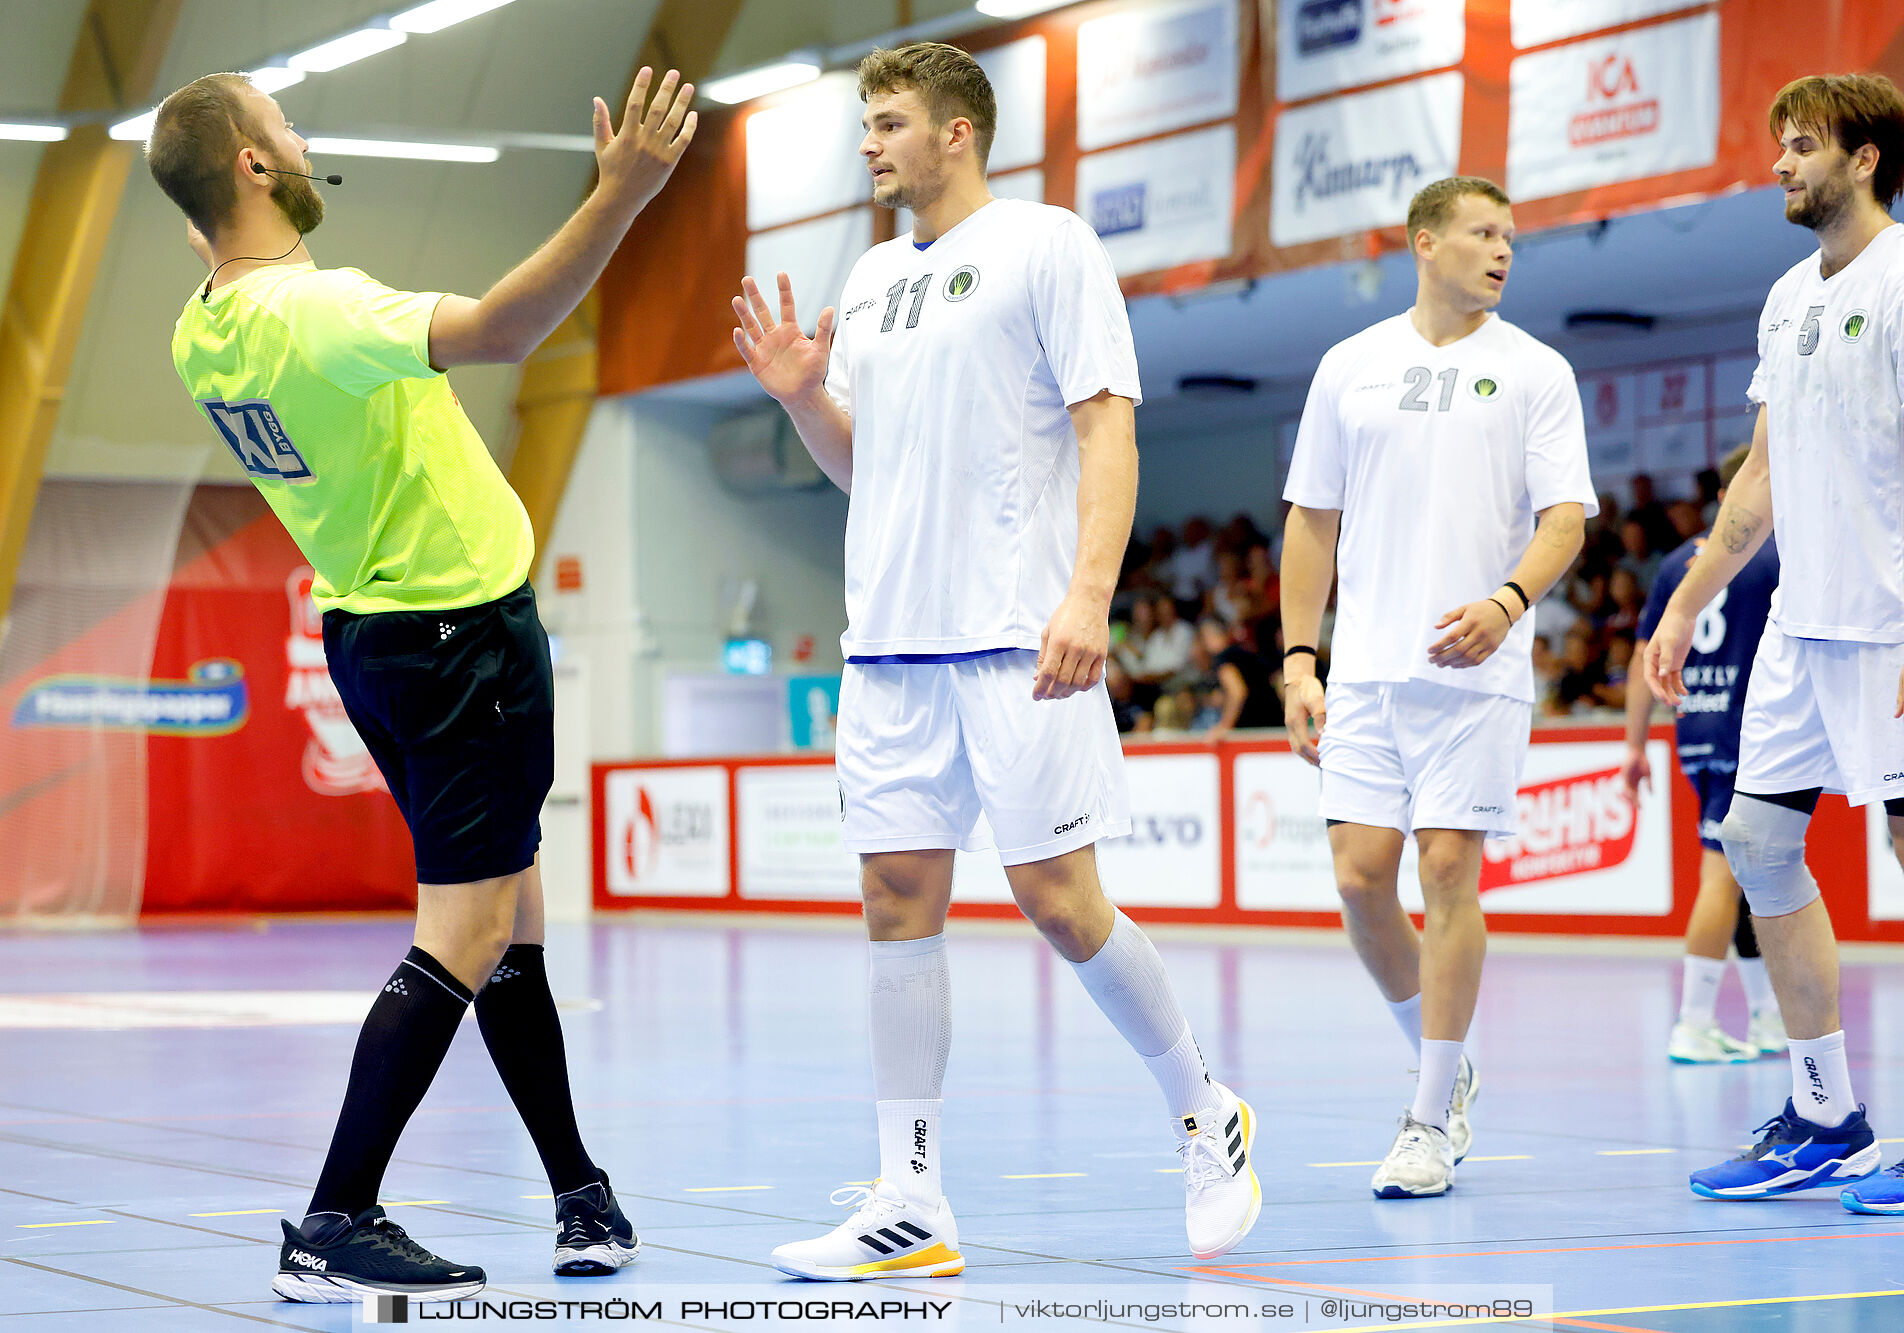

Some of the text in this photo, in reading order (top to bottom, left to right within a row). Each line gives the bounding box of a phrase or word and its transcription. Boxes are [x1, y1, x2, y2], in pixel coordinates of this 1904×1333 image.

[1586, 54, 1638, 102] ICA
[880, 273, 933, 332] 11
[1797, 305, 1825, 356] 5
[1399, 366, 1459, 412] 21
[211, 408, 304, 473] XL
[262, 410, 293, 453] BYGG
[1054, 817, 1084, 835] CRAFT
[1472, 805, 1497, 813] CRAFT
[1804, 1056, 1824, 1090] CRAFT
[914, 1118, 927, 1159] CRAFT
[288, 1248, 328, 1272] HOKA
